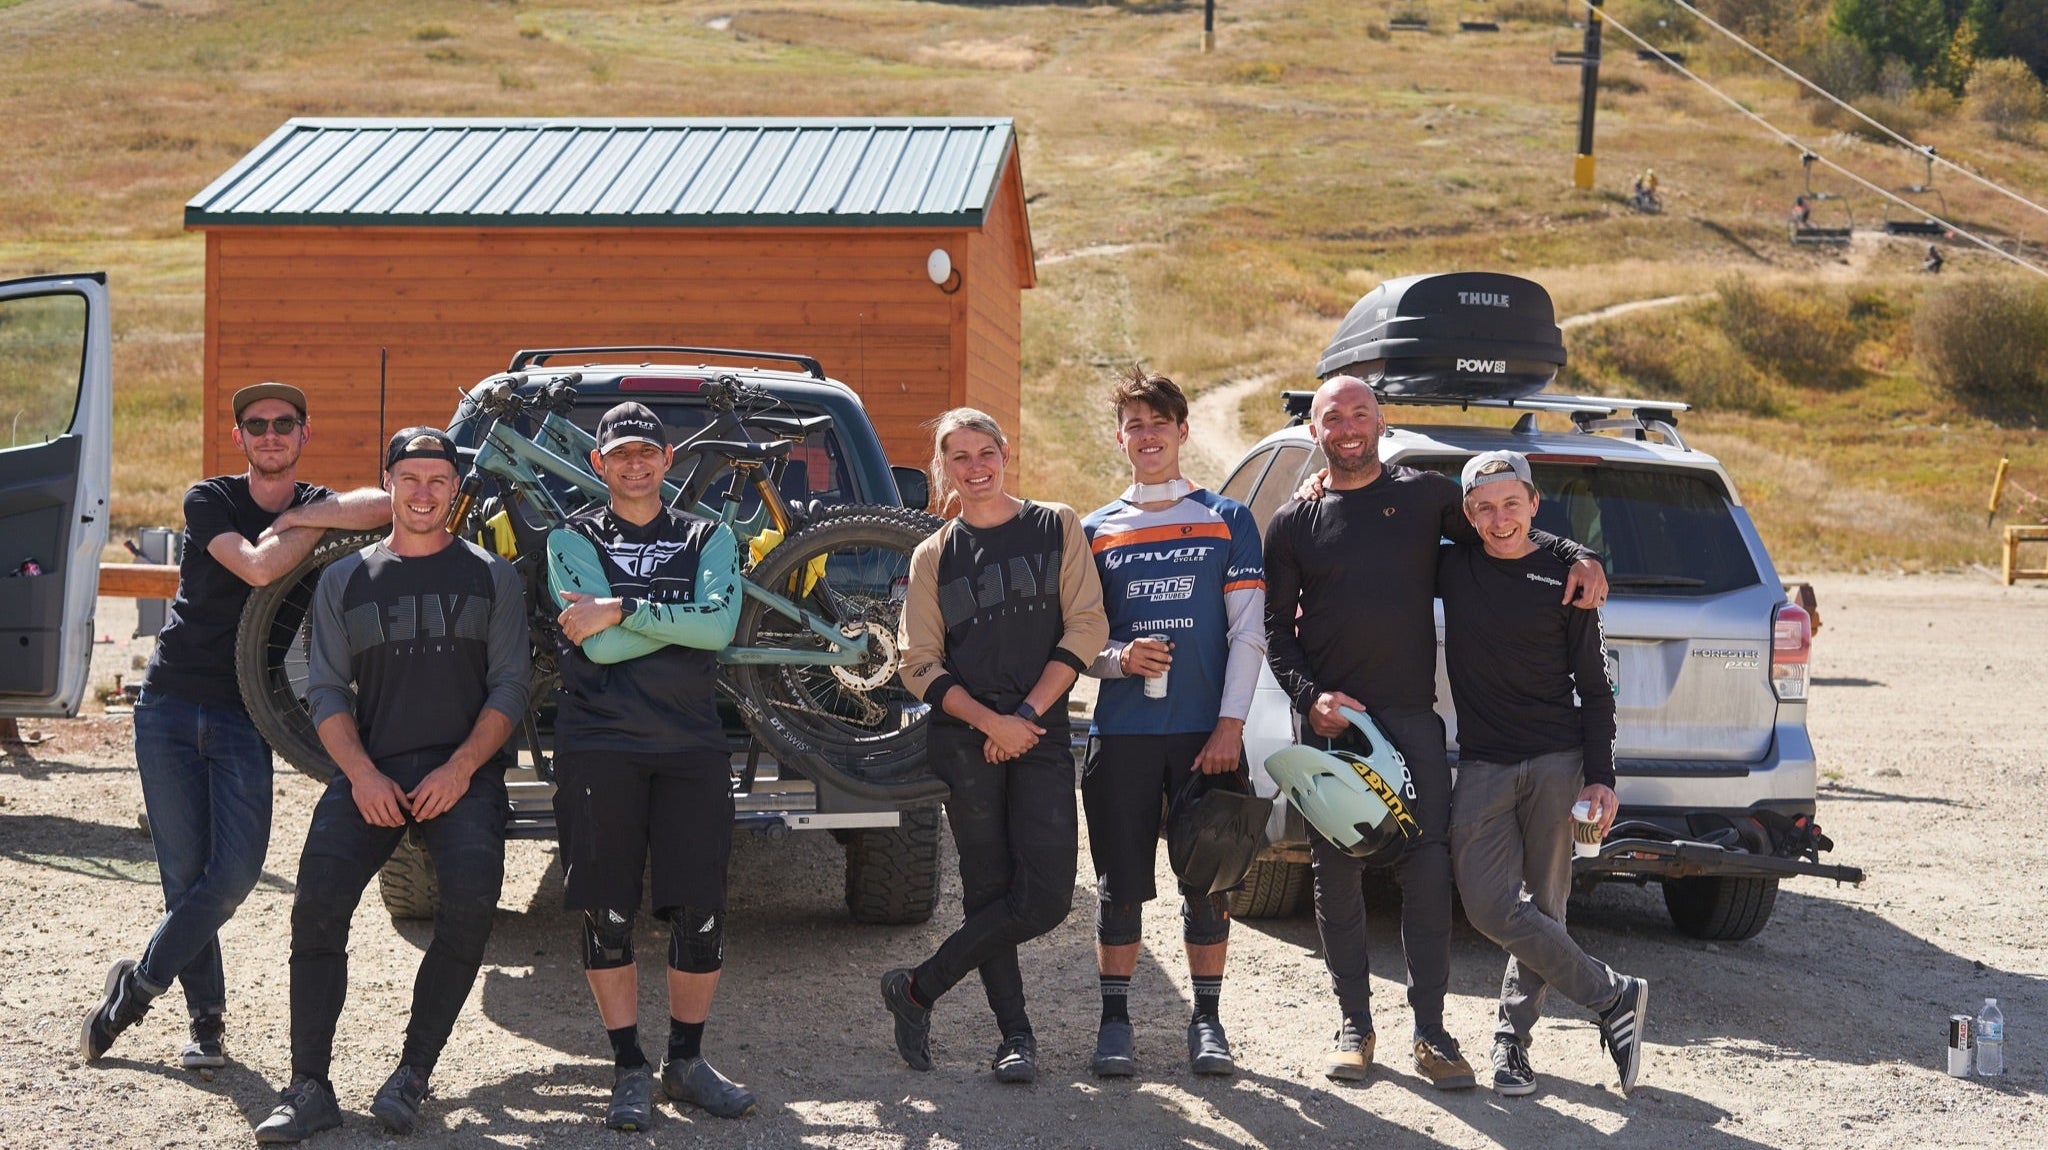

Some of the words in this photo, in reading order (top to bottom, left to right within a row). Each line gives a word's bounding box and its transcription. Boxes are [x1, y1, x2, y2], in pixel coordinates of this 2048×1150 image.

[1458, 292, 1510, 307] THULE
[1456, 359, 1494, 373] POW
[613, 419, 657, 428] PIVOT
[314, 534, 382, 556] MAXXIS
[1124, 546, 1215, 564] PIVOT
[557, 552, 582, 588] FLY
[1240, 567, 1265, 578] PIV
[1131, 617, 1194, 632] SHIMANO
[395, 645, 455, 655] ACING
[1692, 649, 1761, 658] FORESTER
[780, 664, 807, 710] MAXX
[770, 717, 785, 731] DT
